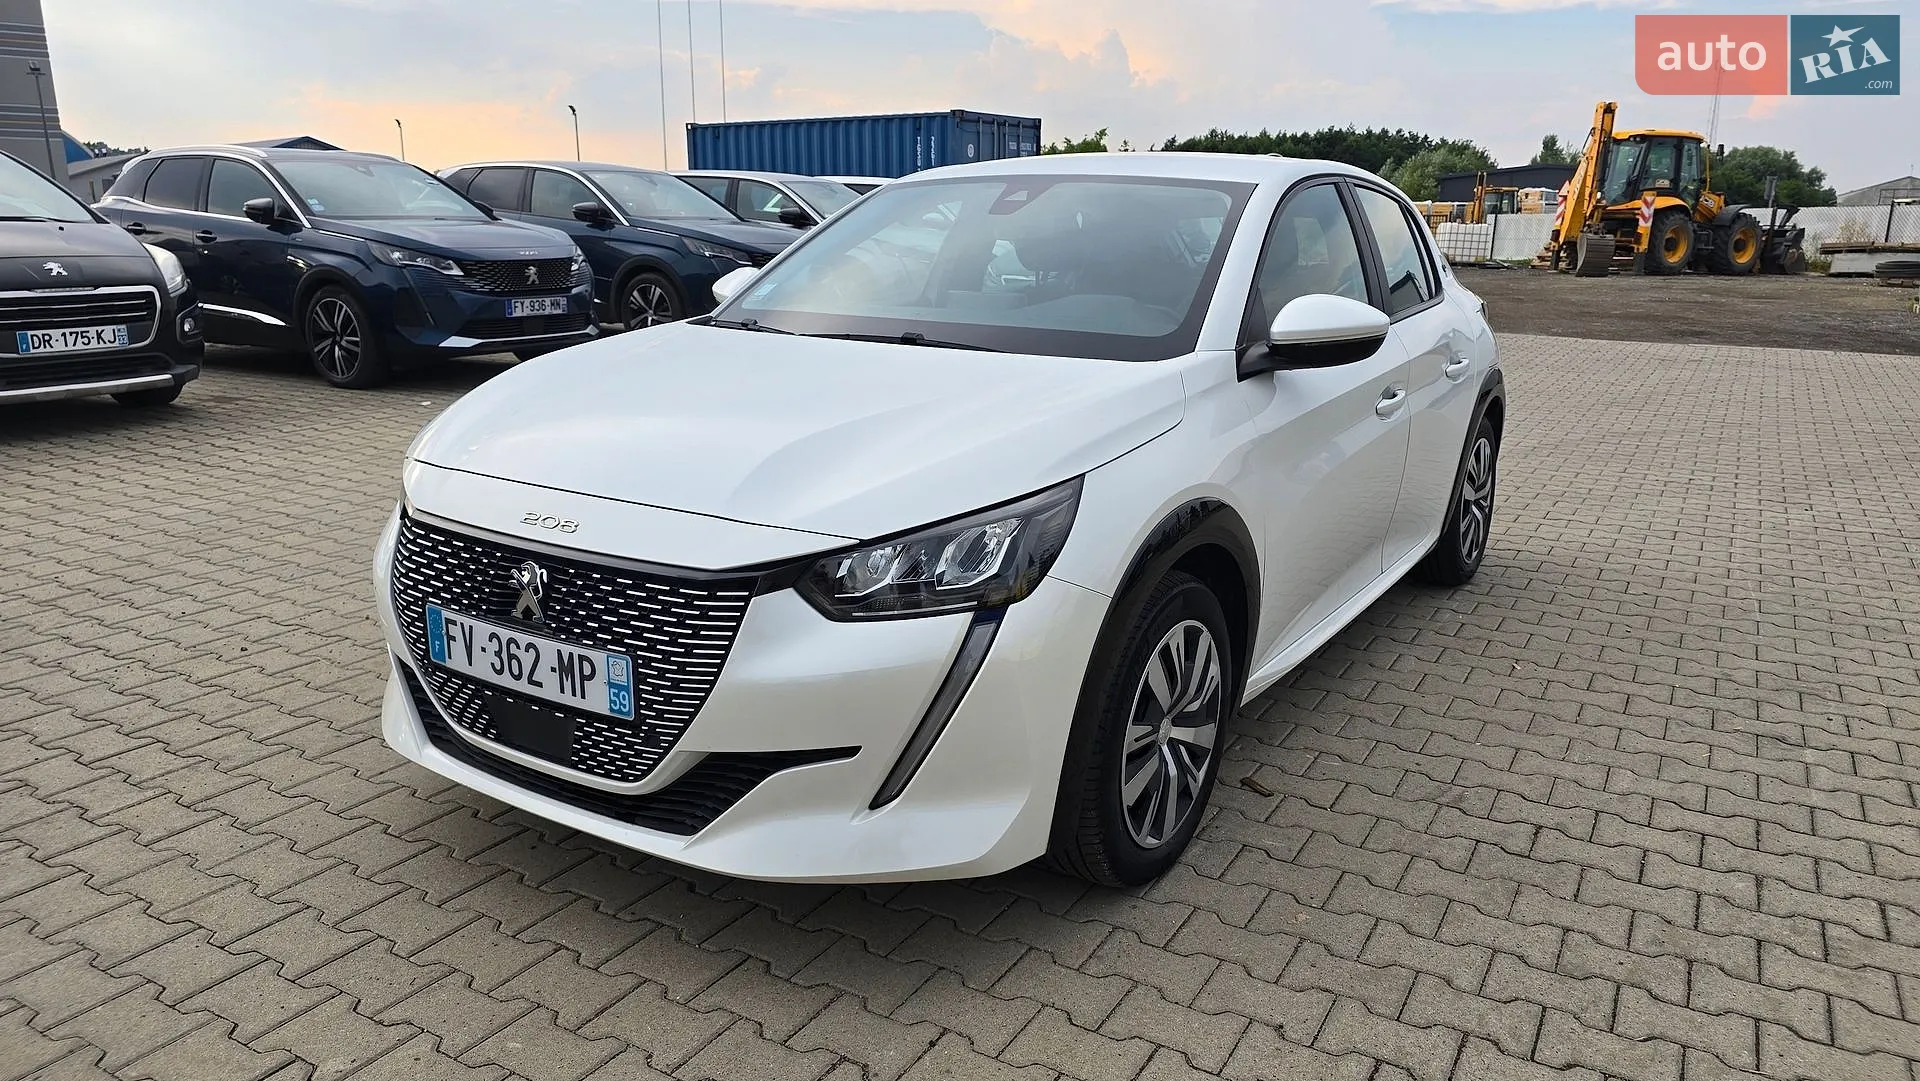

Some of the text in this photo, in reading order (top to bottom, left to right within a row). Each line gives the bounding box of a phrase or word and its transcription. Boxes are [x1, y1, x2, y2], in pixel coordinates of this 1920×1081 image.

[30, 328, 117, 350] DR-175-KJ
[520, 511, 580, 534] 208
[444, 616, 597, 700] FV-362-MP
[610, 688, 629, 712] 59
